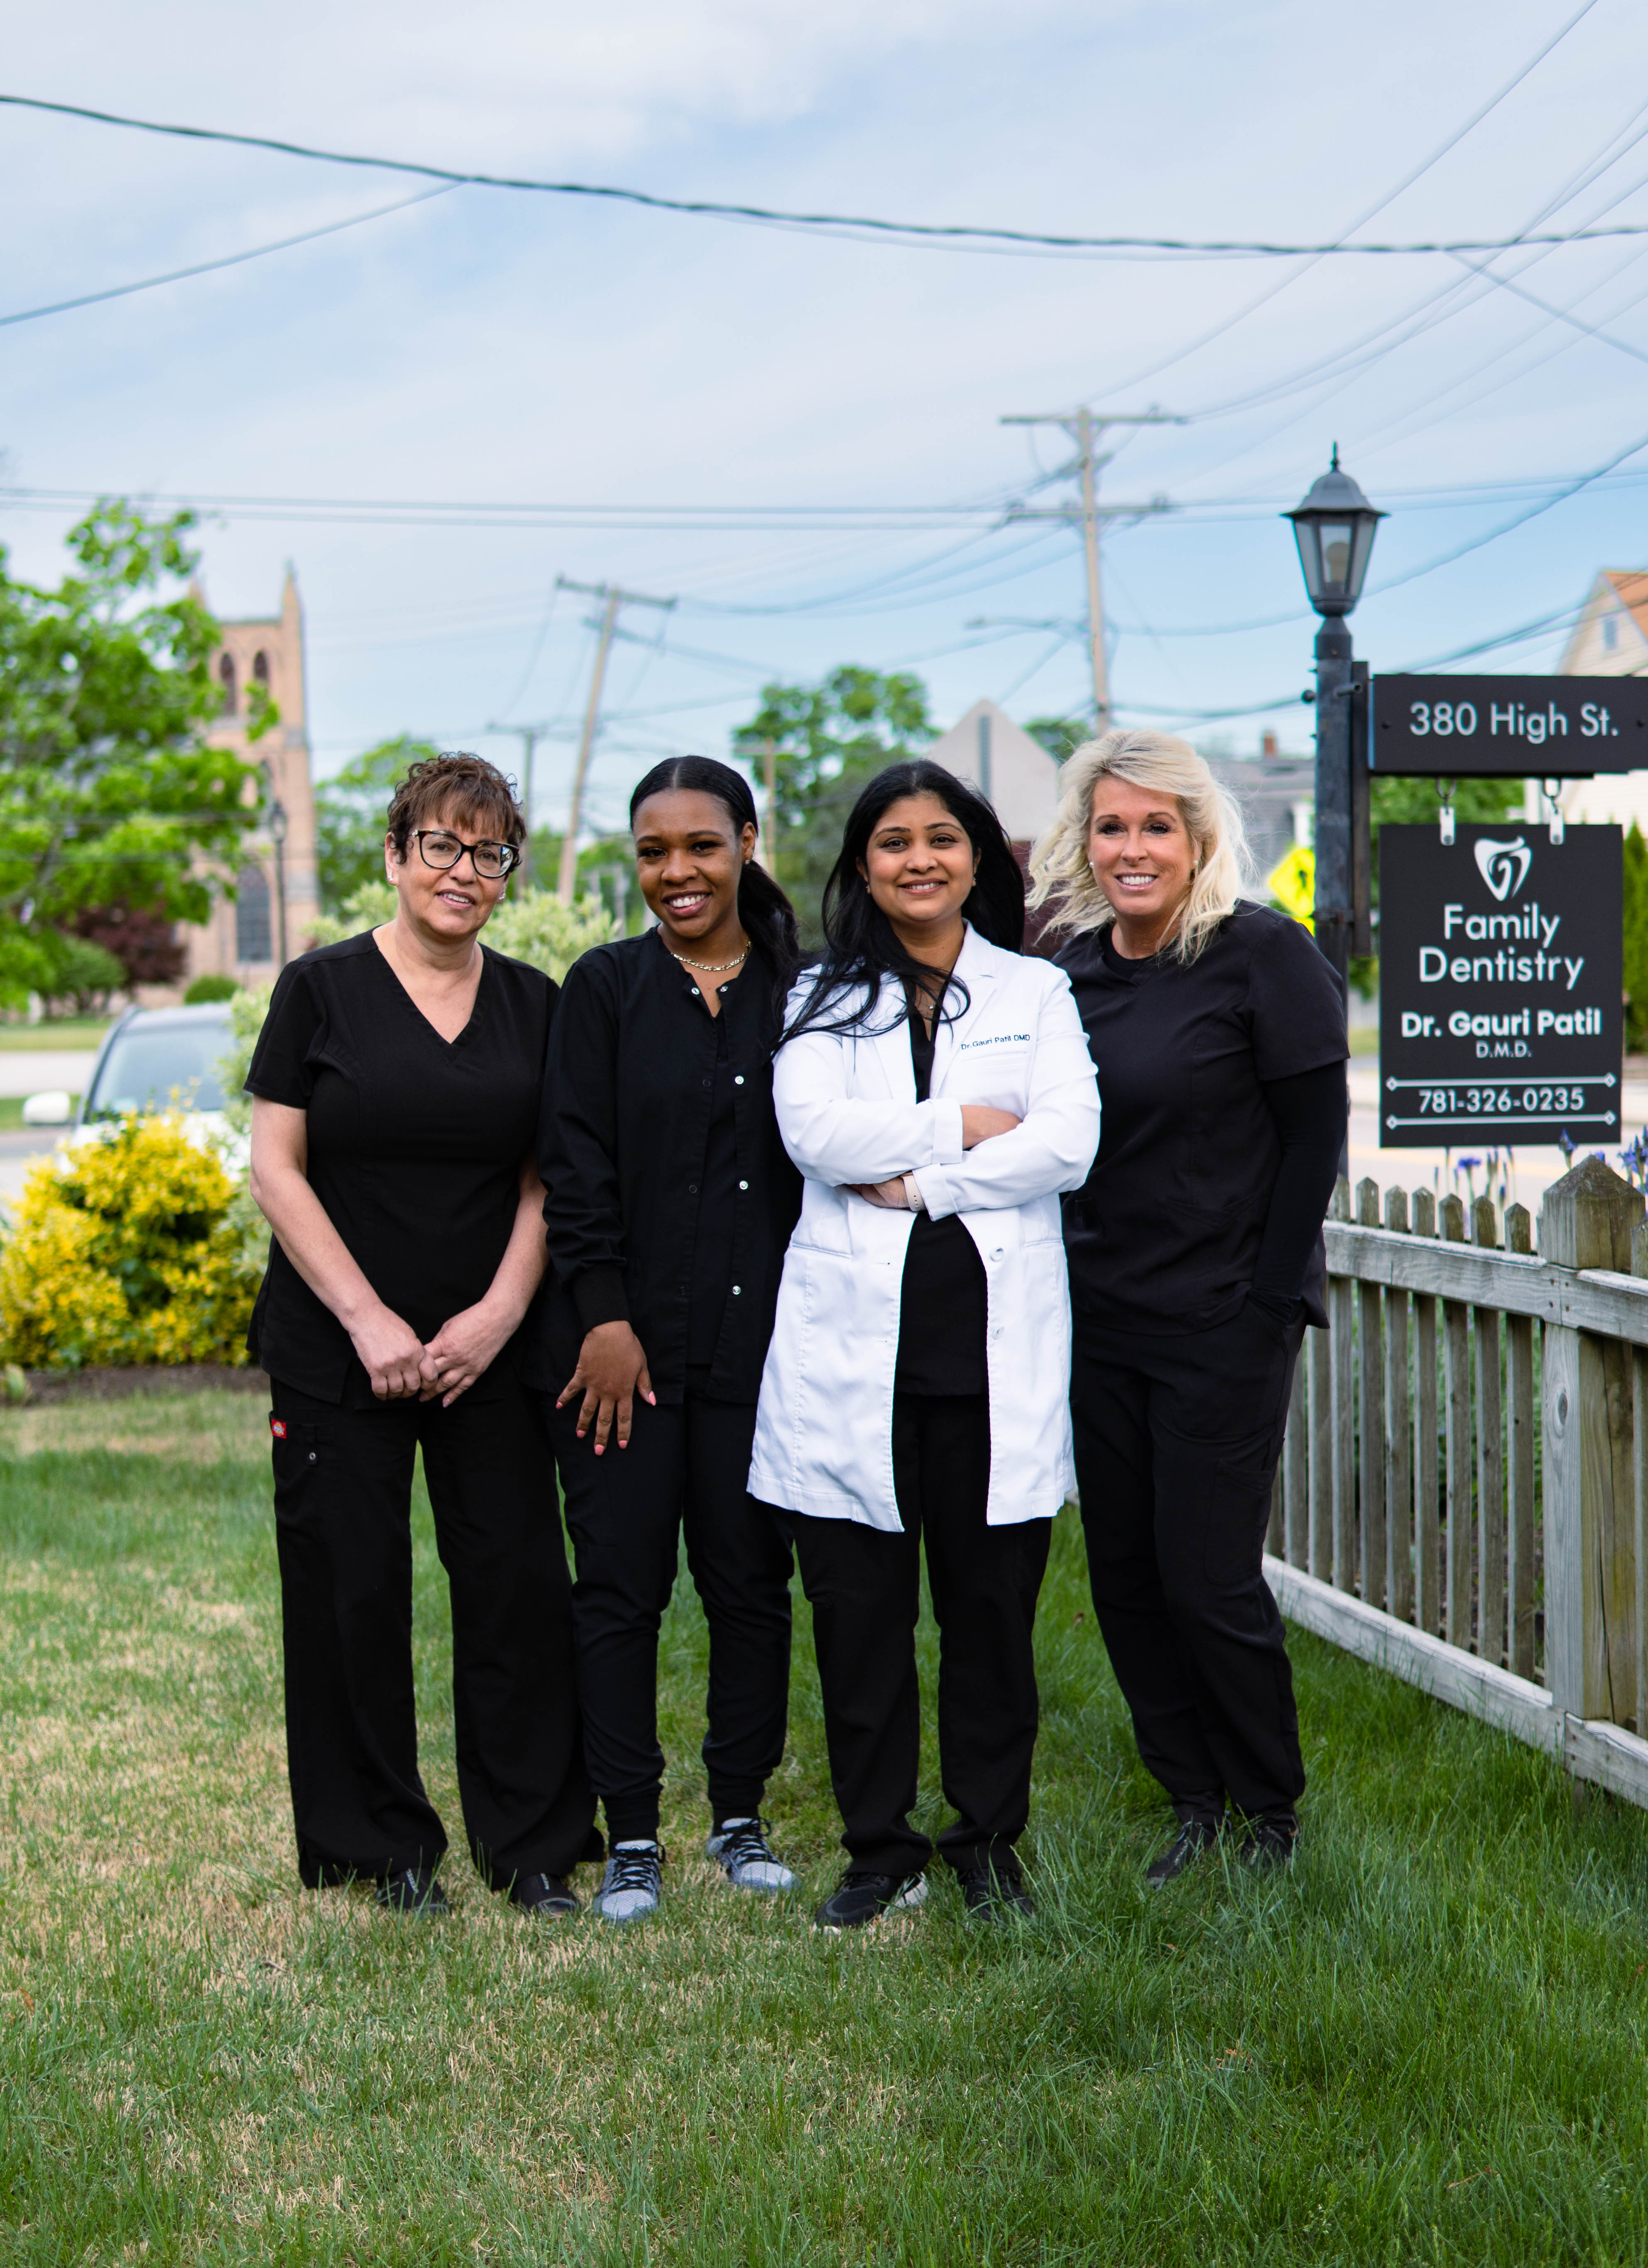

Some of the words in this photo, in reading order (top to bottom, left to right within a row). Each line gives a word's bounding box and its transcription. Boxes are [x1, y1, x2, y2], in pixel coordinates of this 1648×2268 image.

[1410, 702, 1477, 736] 380
[1491, 702, 1567, 744] High
[1581, 703, 1619, 737] St.
[1444, 902, 1560, 948] Family
[1419, 945, 1584, 990] Dentistry
[1401, 1012, 1442, 1038] Dr.
[1448, 1007, 1530, 1037] Gauri
[1537, 1007, 1601, 1036] Patil
[972, 1038, 992, 1047] Gauri
[1476, 1041, 1532, 1058] D.M.D.
[1418, 1087, 1584, 1113] 781-326-0235
